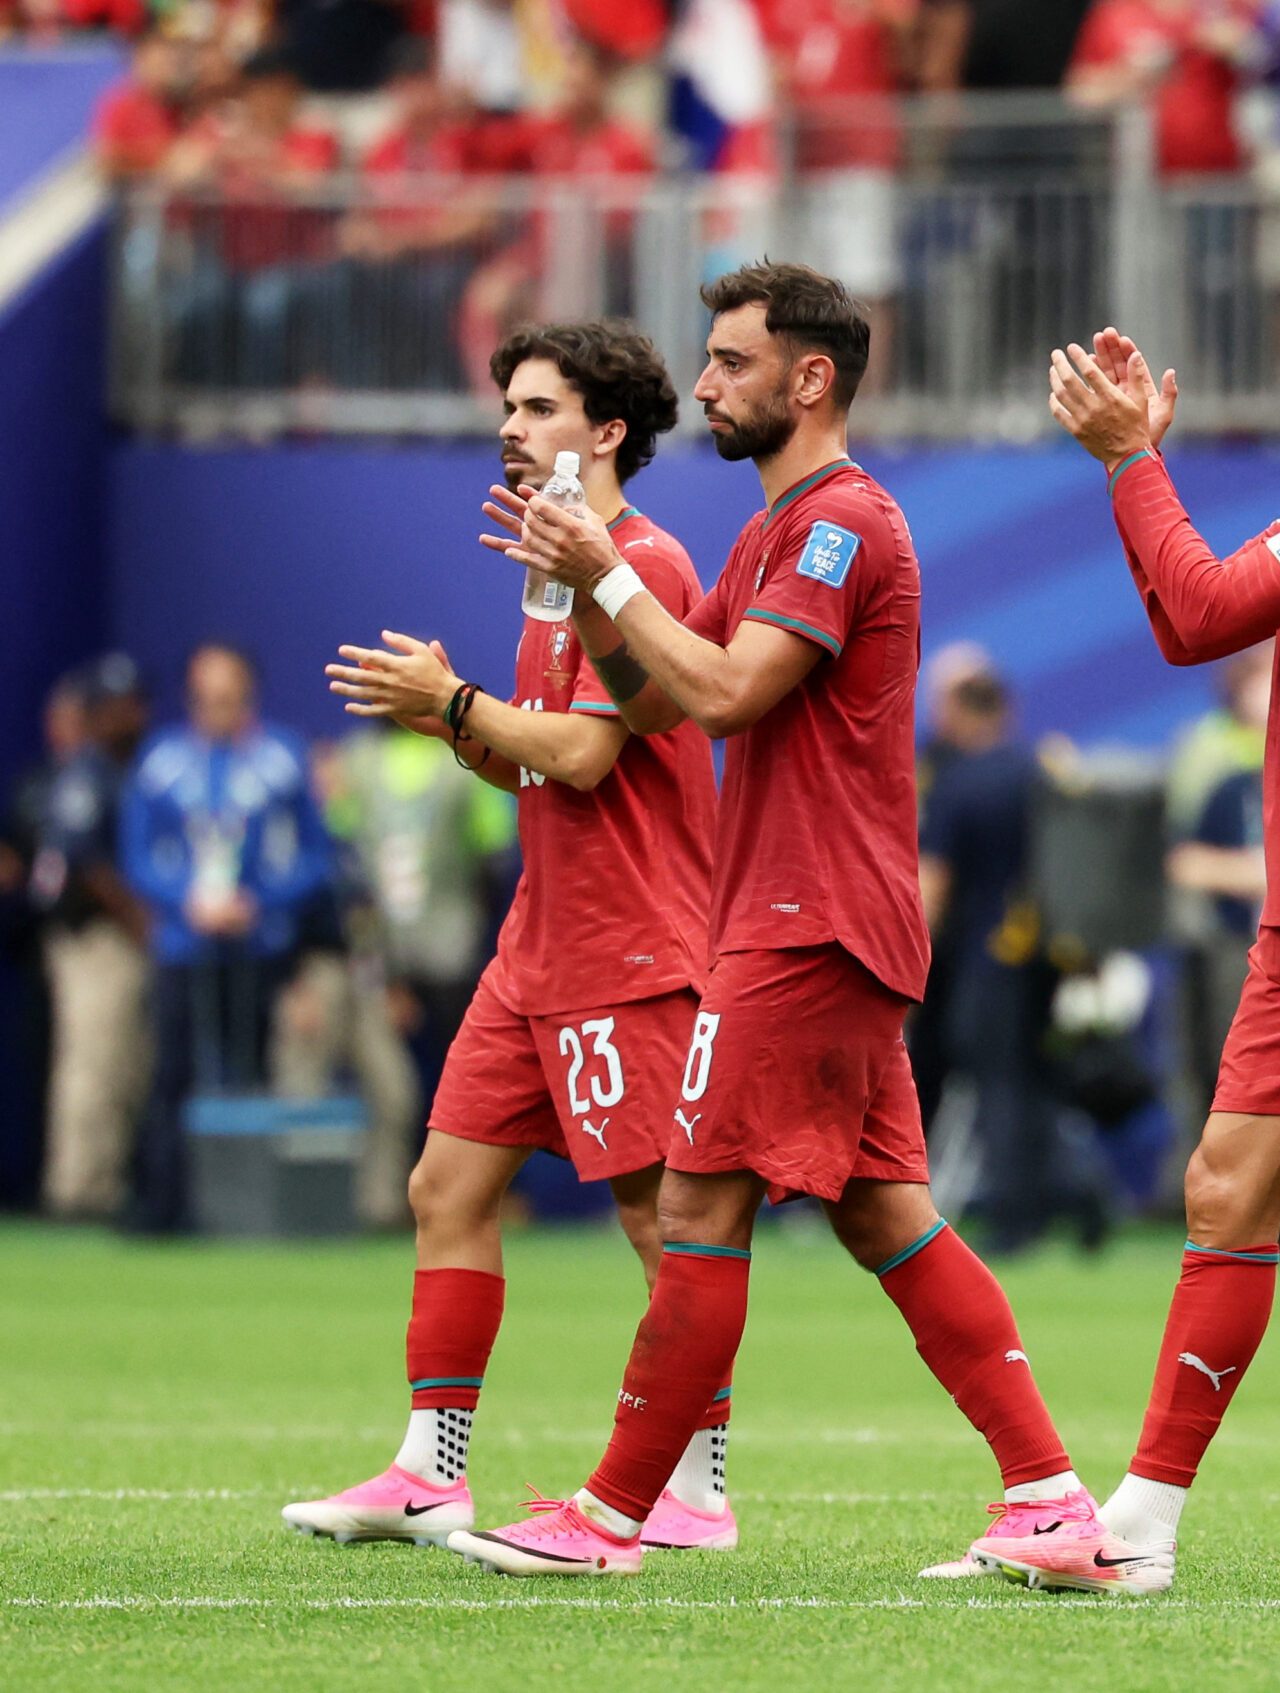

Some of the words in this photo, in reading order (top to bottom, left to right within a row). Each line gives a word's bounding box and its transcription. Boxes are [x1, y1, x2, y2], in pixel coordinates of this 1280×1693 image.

[812, 554, 836, 573] PEACE
[559, 1016, 625, 1117] 23
[682, 1011, 721, 1102] 8
